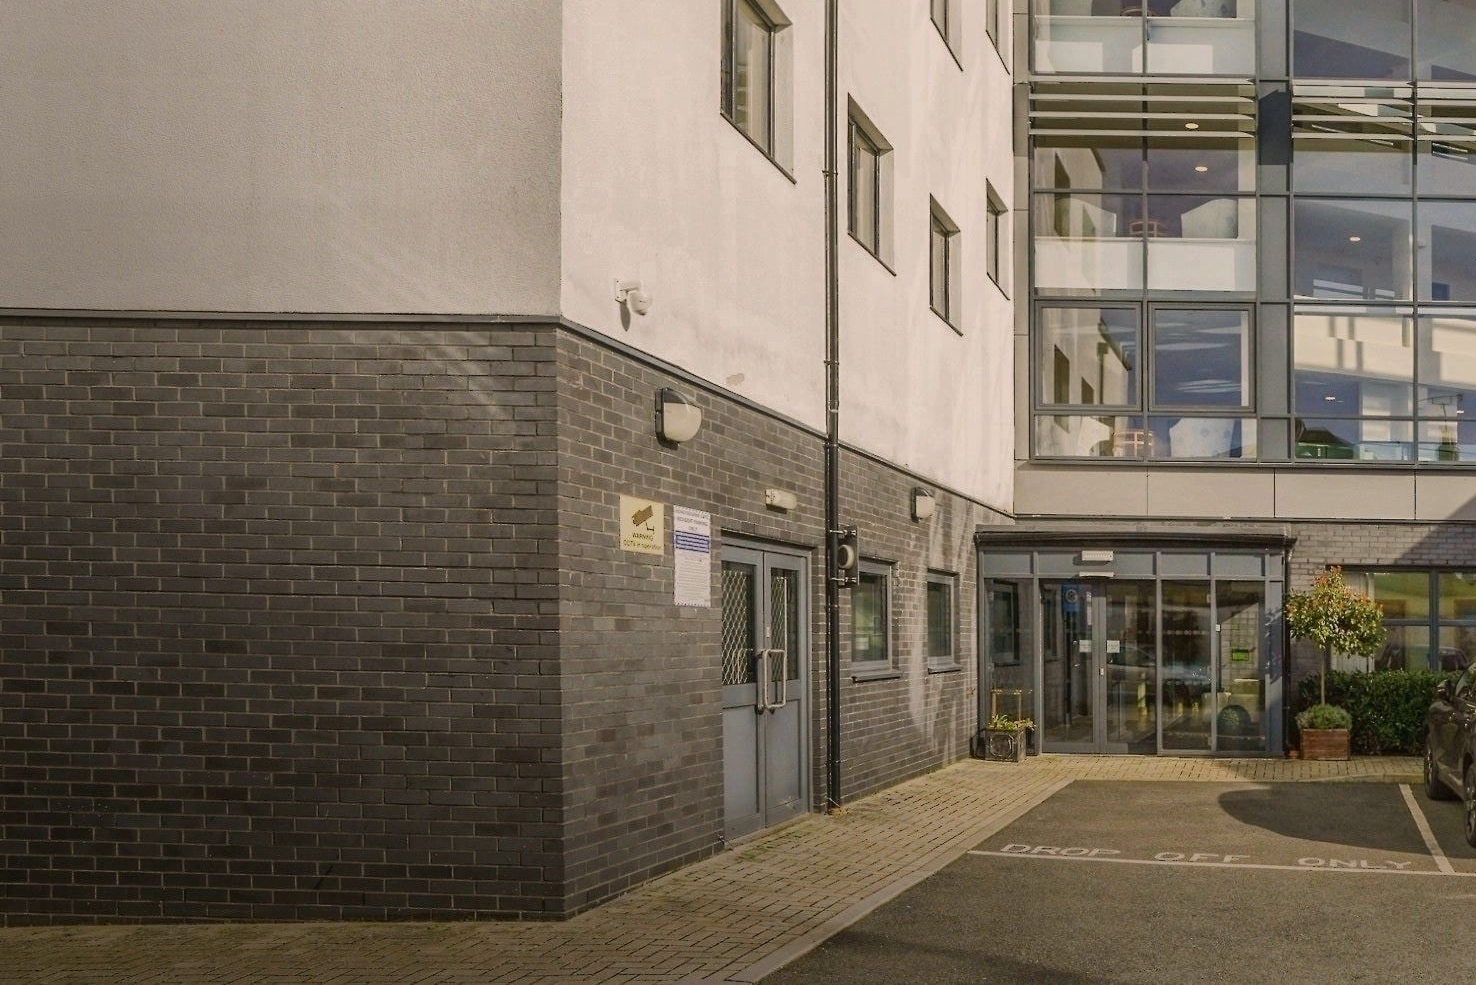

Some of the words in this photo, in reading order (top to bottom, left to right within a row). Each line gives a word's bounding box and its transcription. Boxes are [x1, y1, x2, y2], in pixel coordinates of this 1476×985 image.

[632, 532, 654, 542] WARNING
[1000, 843, 1121, 857] DROP
[1154, 851, 1250, 863] OFF
[1297, 857, 1412, 869] ONLY
